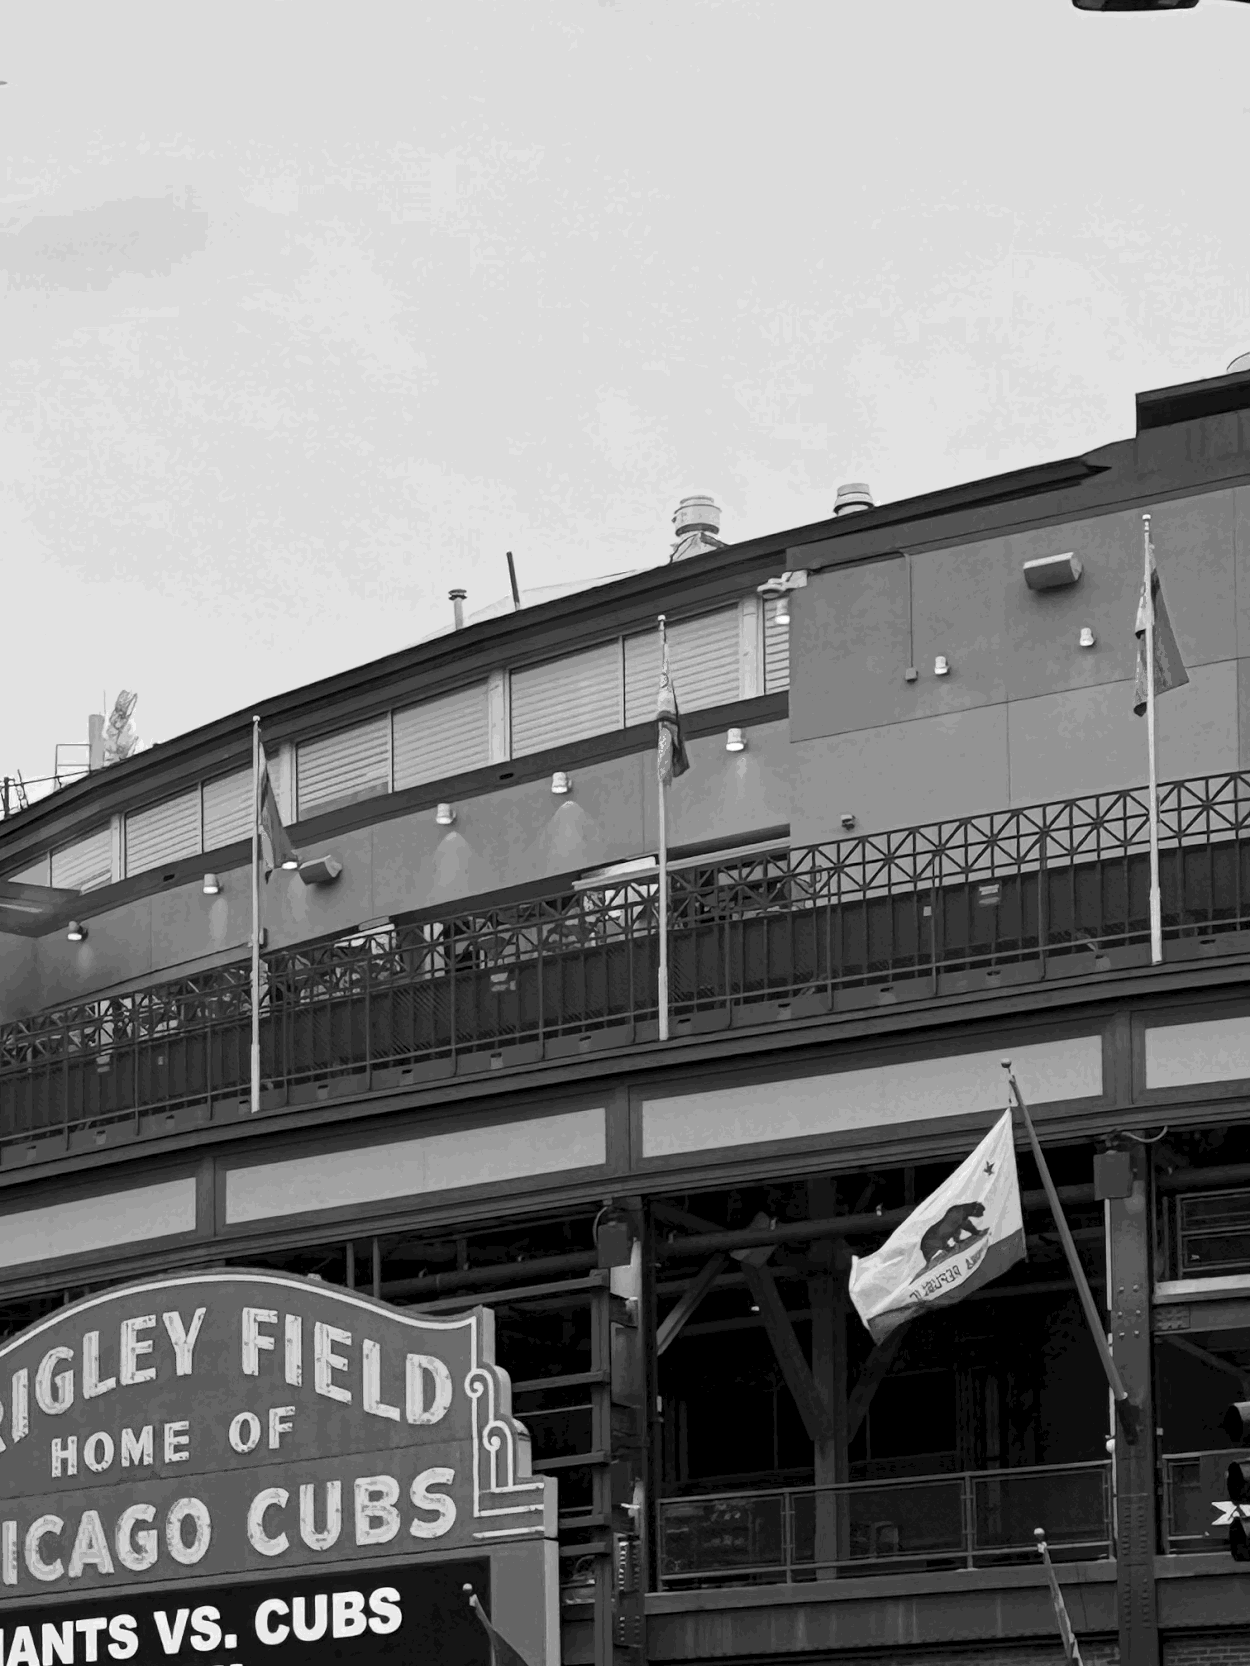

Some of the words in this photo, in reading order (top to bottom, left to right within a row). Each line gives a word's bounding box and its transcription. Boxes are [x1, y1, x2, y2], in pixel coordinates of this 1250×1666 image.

[242, 1307, 452, 1425] FIELD
[52, 1421, 191, 1478] HOME
[229, 1406, 296, 1454] OF
[247, 1467, 457, 1556] CUBS
[154, 1606, 237, 1654] VS.
[255, 1587, 404, 1645] CUBS
